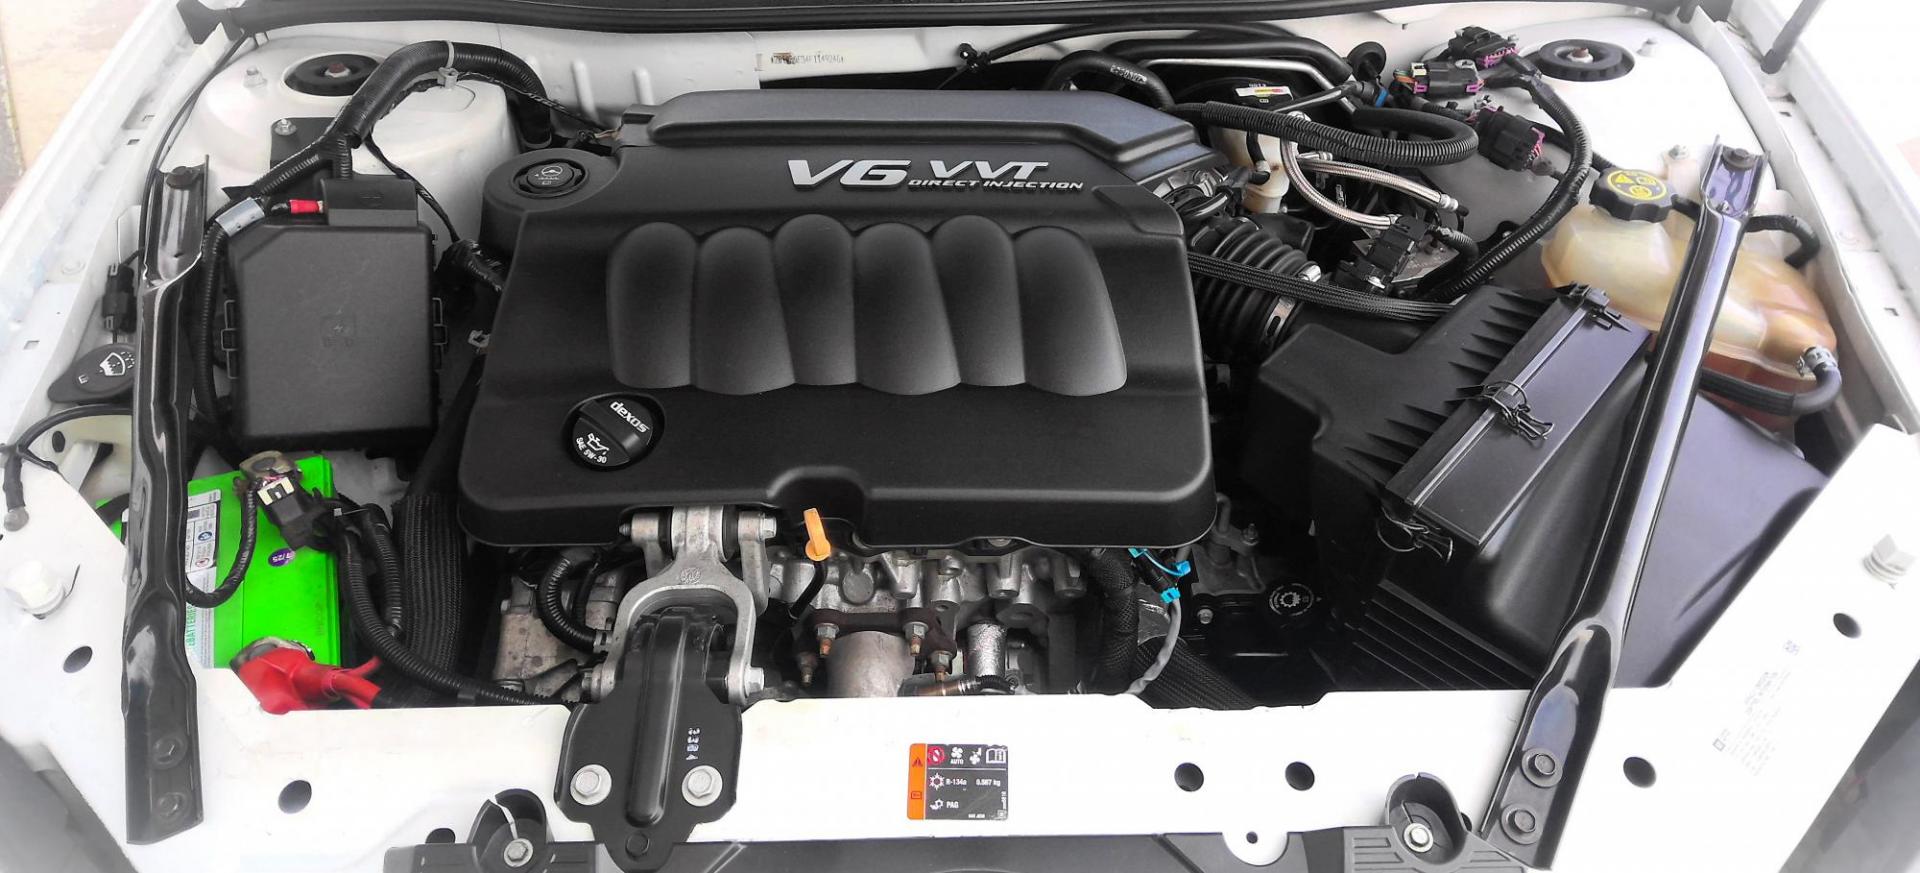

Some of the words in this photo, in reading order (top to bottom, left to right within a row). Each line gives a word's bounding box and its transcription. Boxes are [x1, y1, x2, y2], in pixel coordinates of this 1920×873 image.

[788, 160, 911, 187] V6
[929, 160, 1049, 180] VVT
[908, 179, 979, 188] DIRECT
[983, 180, 1084, 189] INJECTION
[610, 401, 650, 433] dexos
[576, 437, 587, 451] SAE
[583, 449, 607, 464] 5W-30
